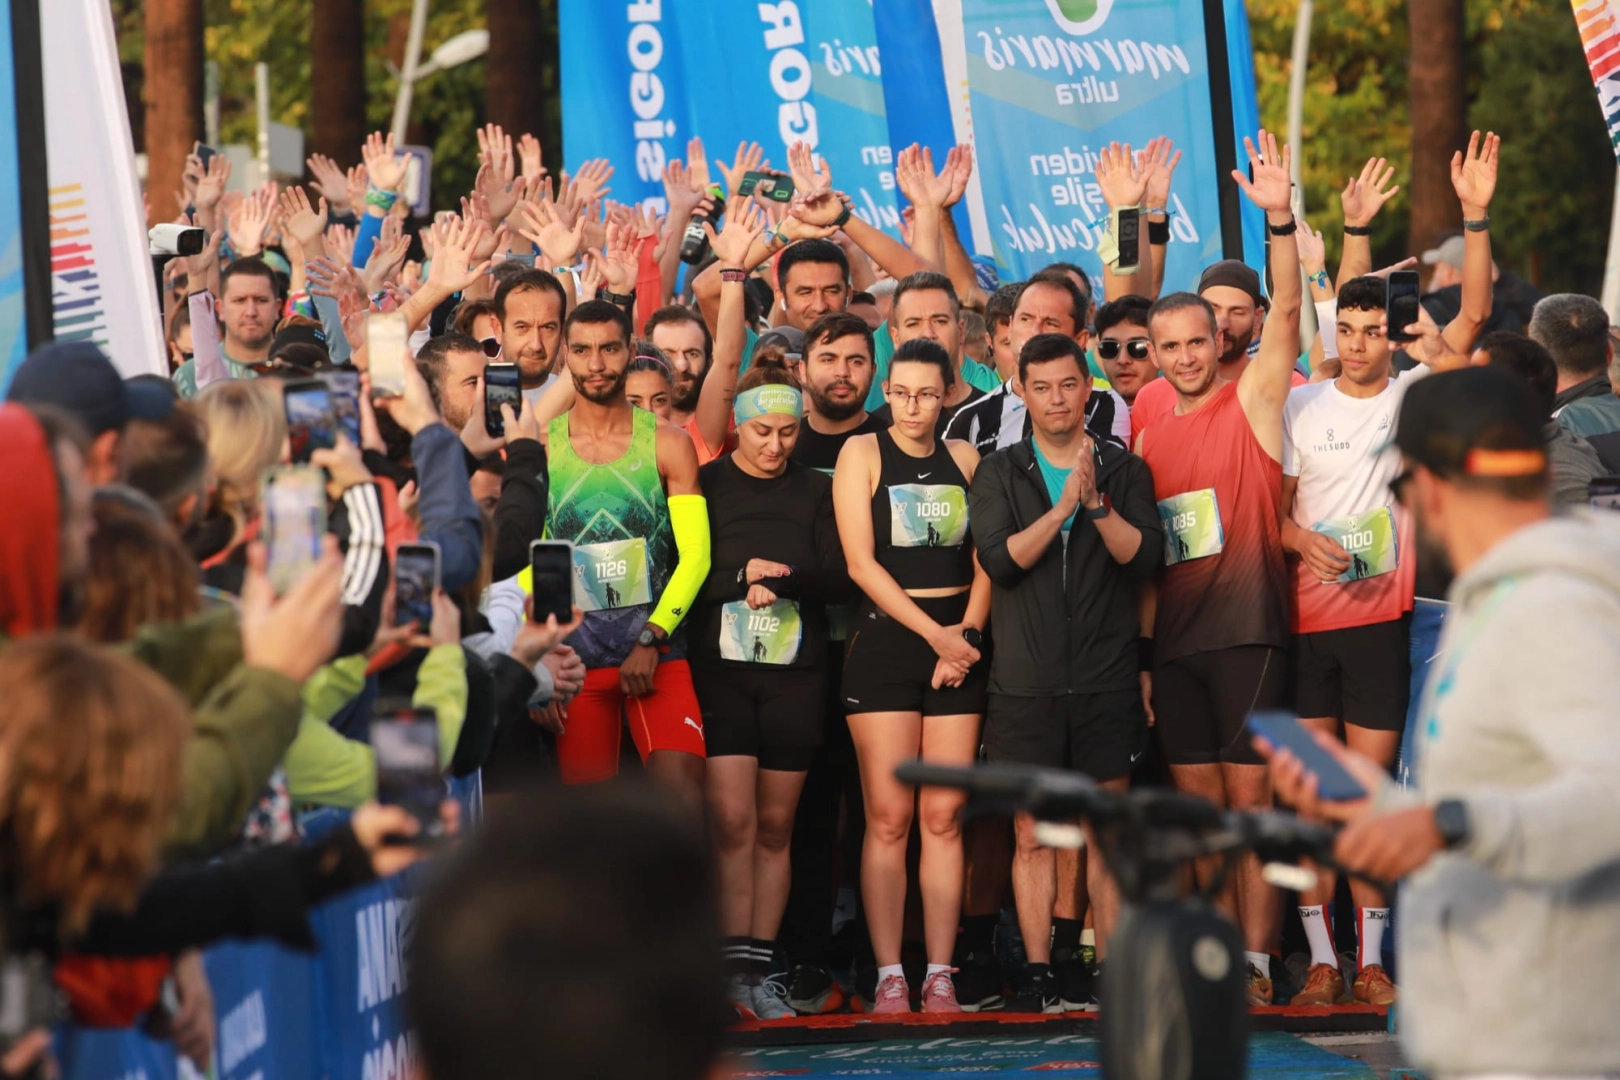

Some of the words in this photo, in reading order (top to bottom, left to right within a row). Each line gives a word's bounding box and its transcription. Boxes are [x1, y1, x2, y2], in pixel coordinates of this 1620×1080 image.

[916, 502, 951, 517] 1080
[1172, 511, 1196, 531] 1085
[1341, 530, 1373, 550] 1100
[595, 560, 627, 579] 1126
[748, 615, 780, 632] 1102
